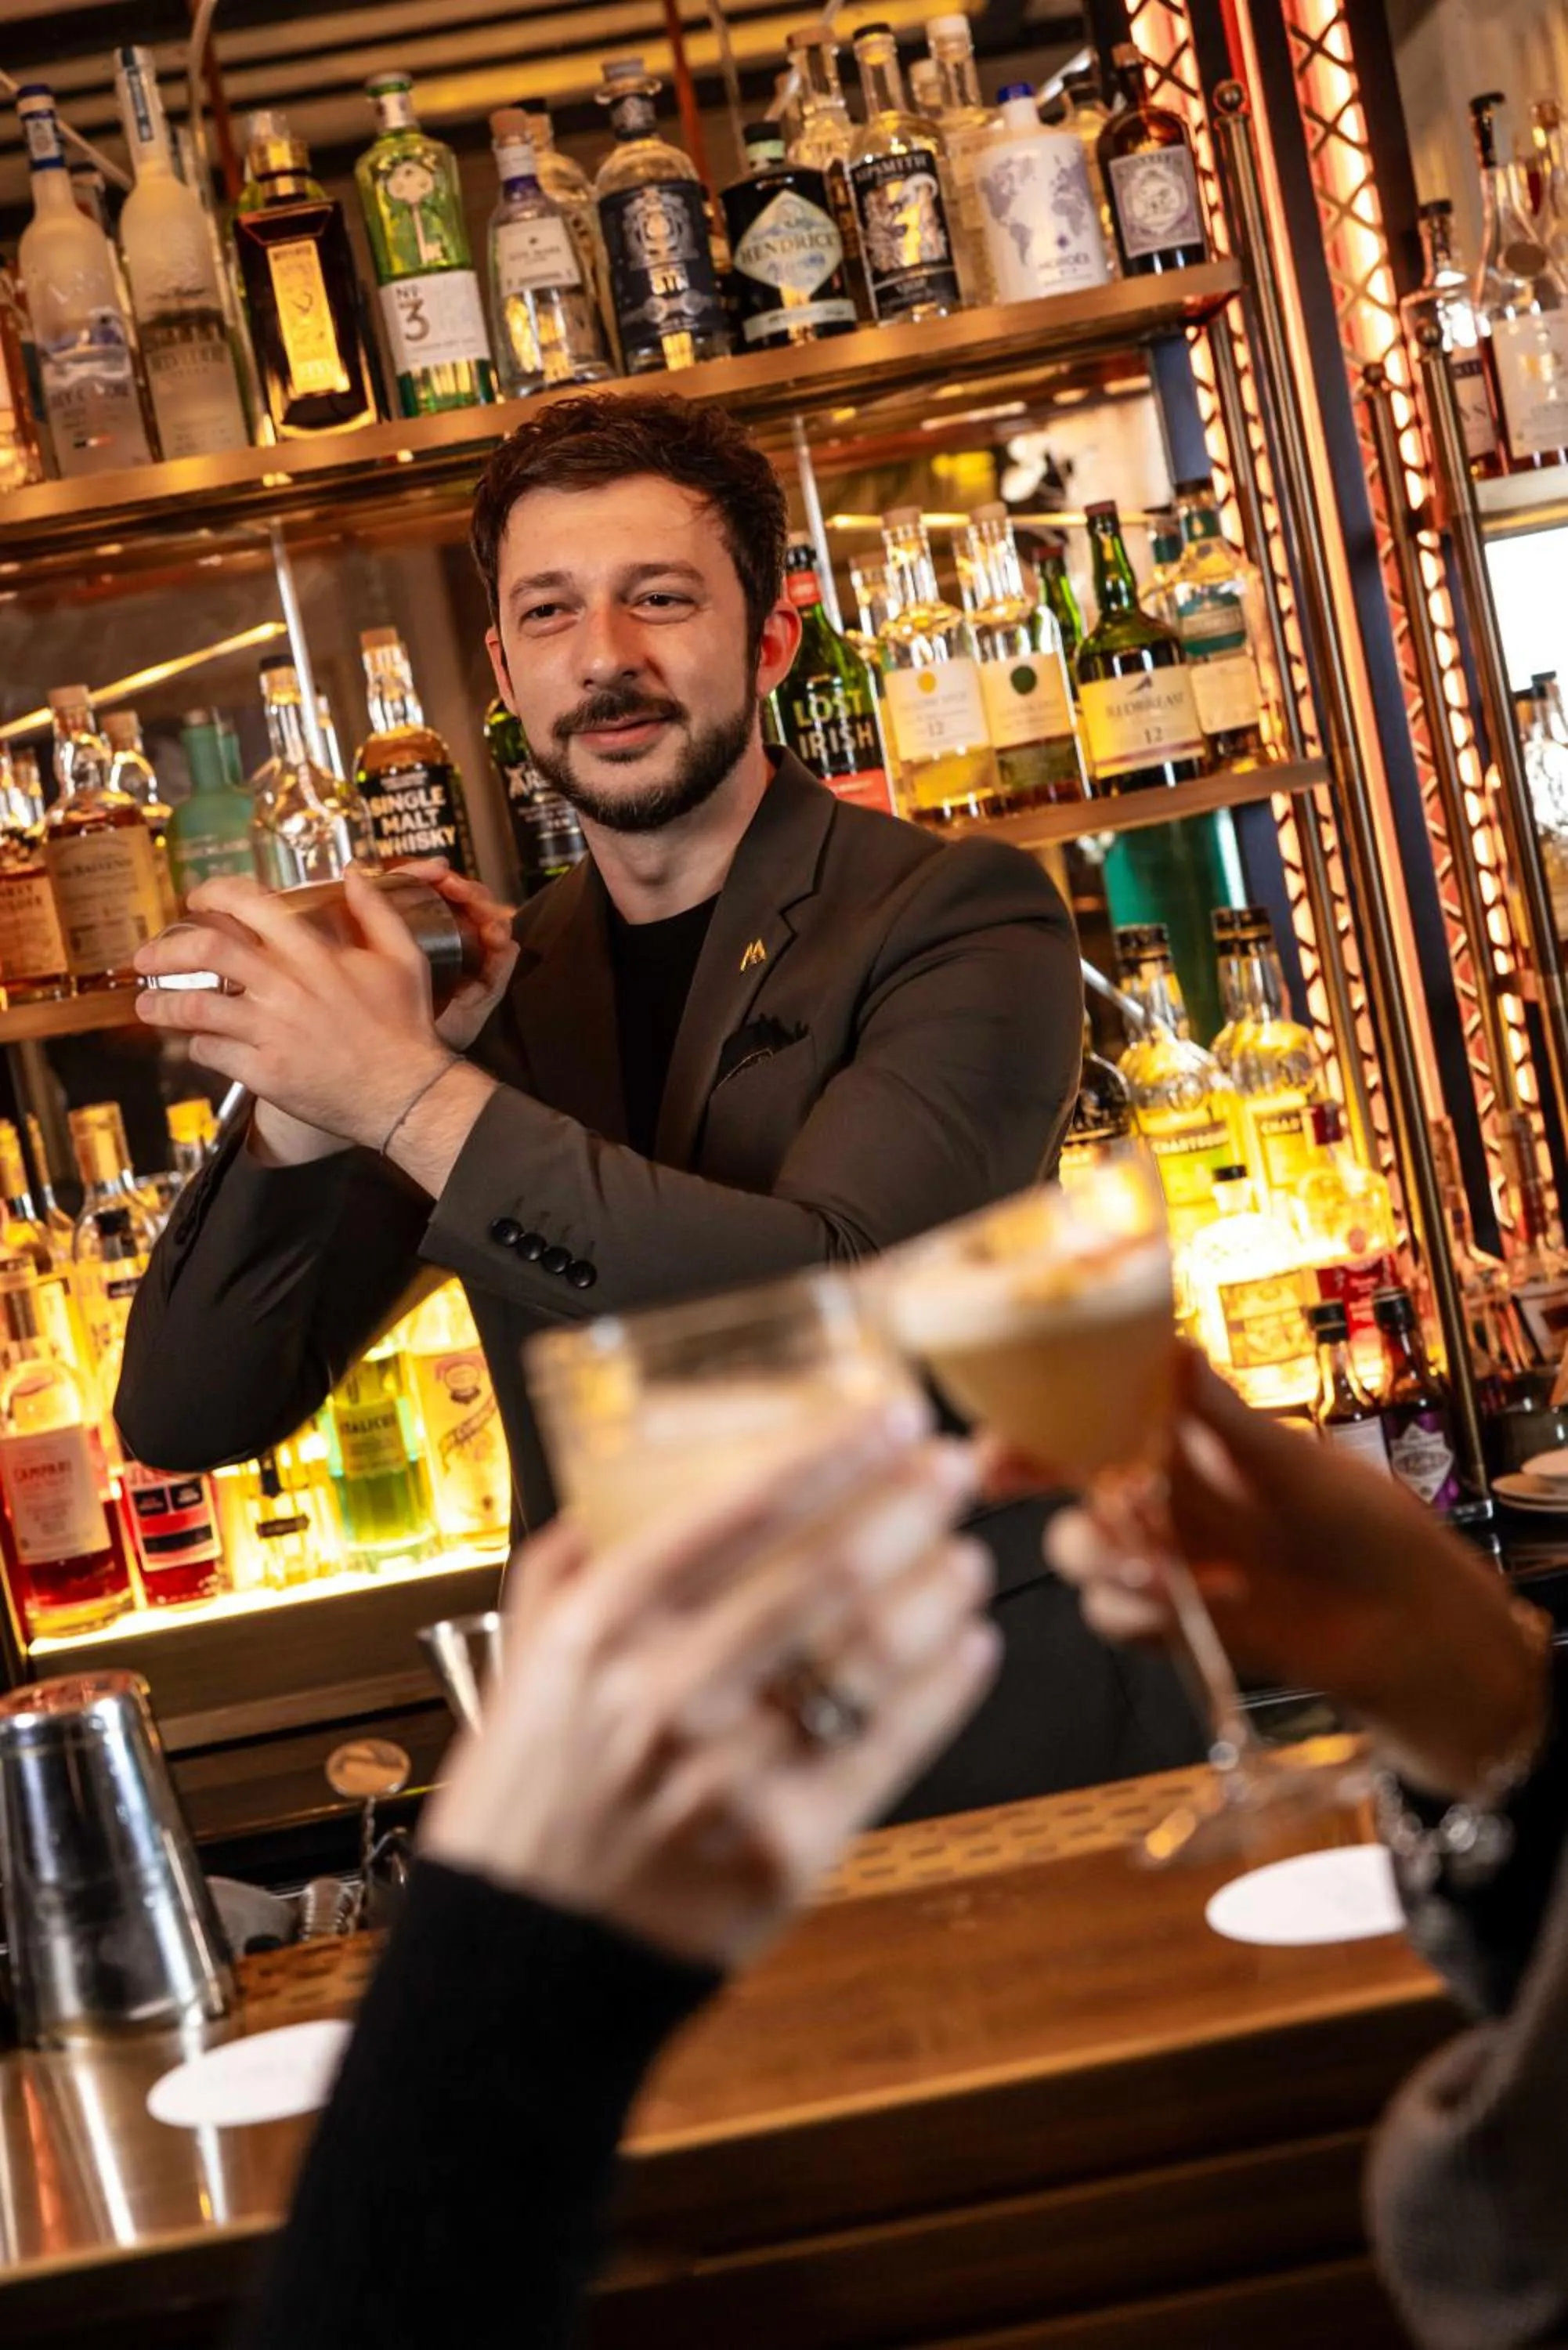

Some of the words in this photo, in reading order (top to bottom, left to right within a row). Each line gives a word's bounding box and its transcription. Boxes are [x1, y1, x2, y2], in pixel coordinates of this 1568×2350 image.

[398, 298, 431, 342] 3
[792, 689, 862, 728] LOST
[797, 721, 875, 760] IRISH
[370, 785, 446, 818] SINGLE
[381, 808, 439, 835] MALT
[376, 825, 455, 858] WHISKY
